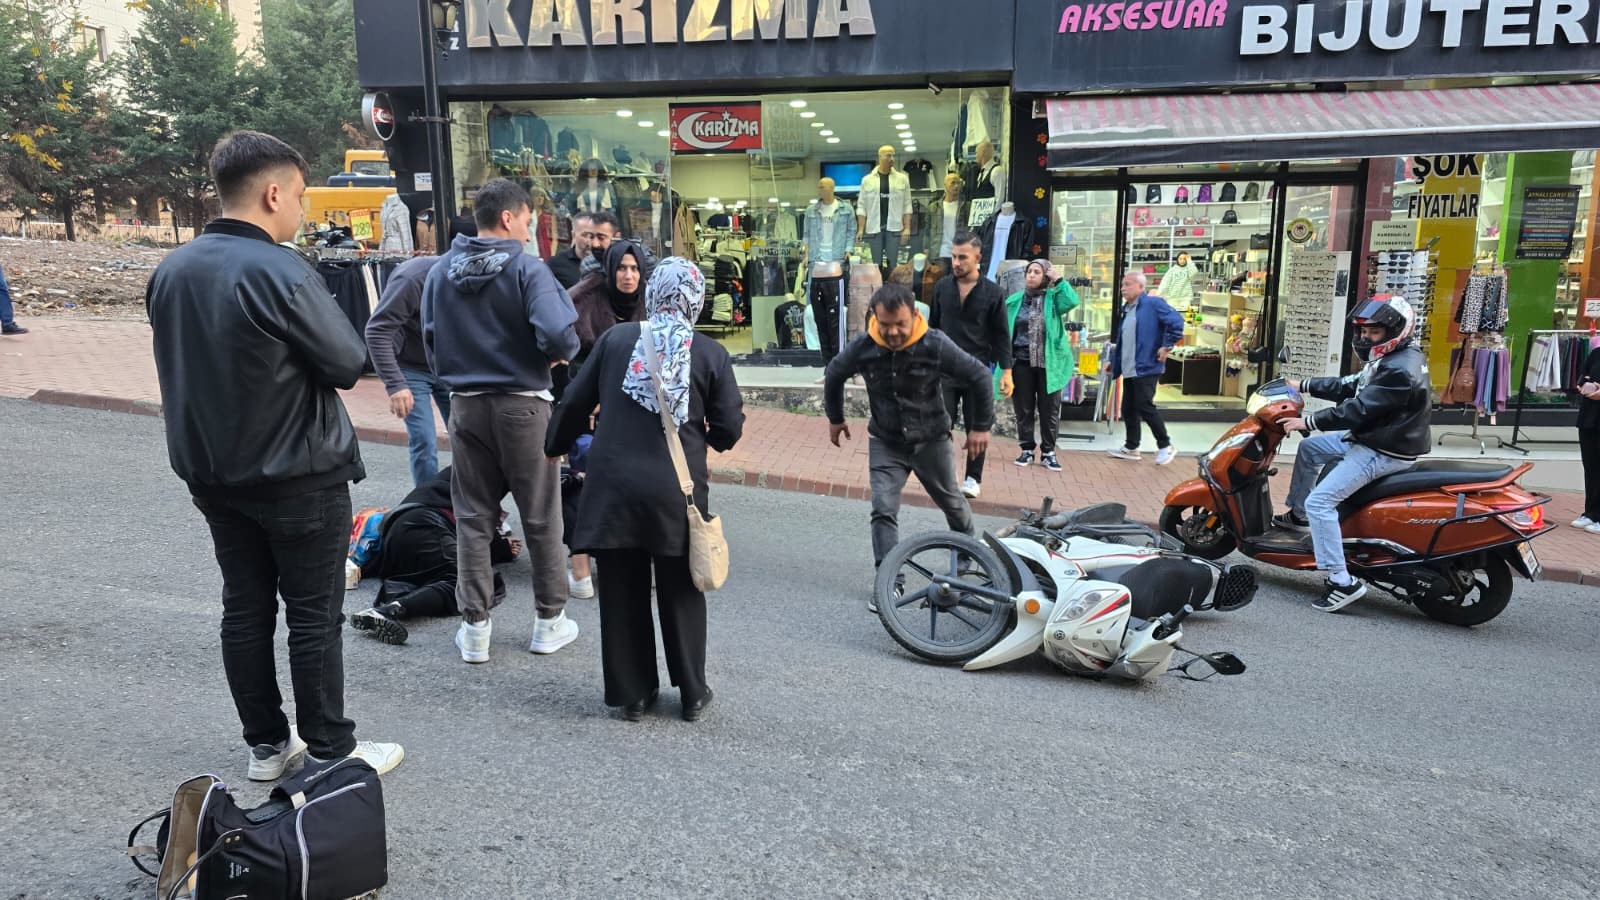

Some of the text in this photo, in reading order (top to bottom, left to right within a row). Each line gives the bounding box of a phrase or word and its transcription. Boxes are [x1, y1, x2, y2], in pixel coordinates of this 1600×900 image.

[1058, 0, 1228, 33] AKSESUAR
[1239, 0, 1600, 55] BIJUTER
[1408, 188, 1479, 218] FİYATLAR
